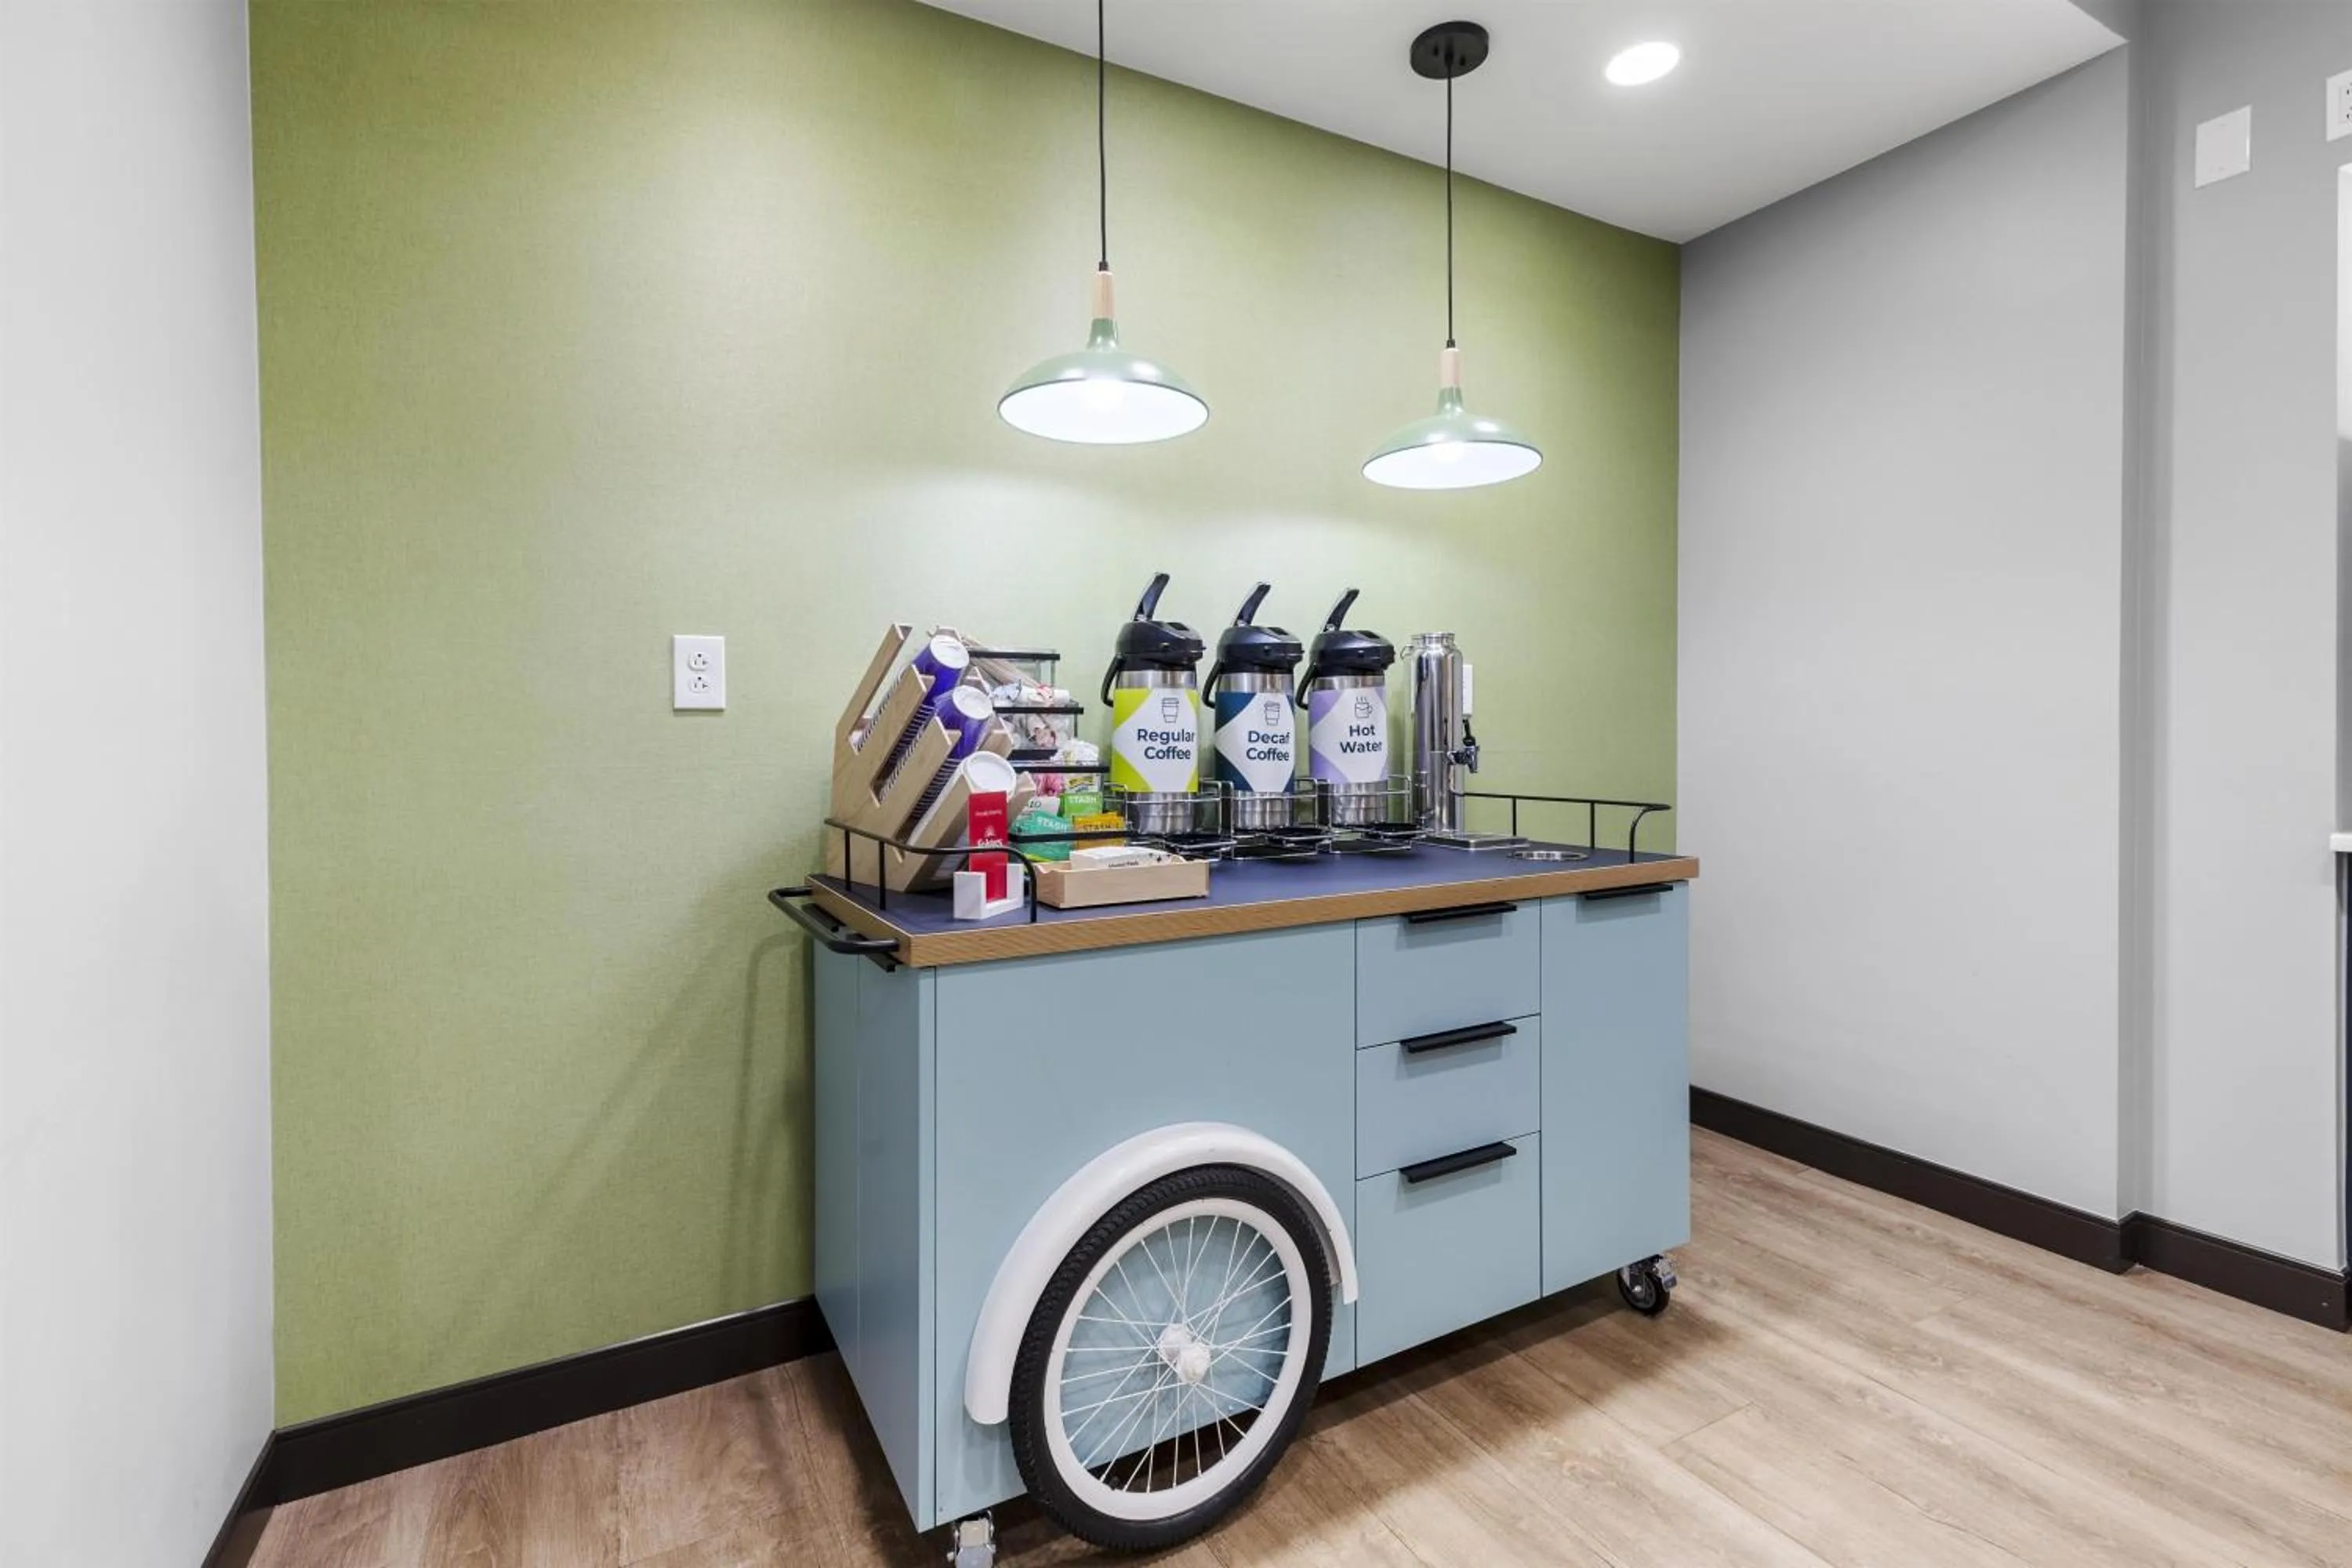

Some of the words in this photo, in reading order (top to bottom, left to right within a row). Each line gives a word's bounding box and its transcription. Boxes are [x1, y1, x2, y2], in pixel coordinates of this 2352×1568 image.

[1137, 728, 1196, 746] Regular
[1248, 730, 1290, 744] Decaf
[1349, 724, 1376, 737] Hot
[1144, 746, 1191, 760] Coffee
[1246, 747, 1290, 761] Coffee
[1340, 741, 1382, 753] Water
[1069, 796, 1098, 804] STASH
